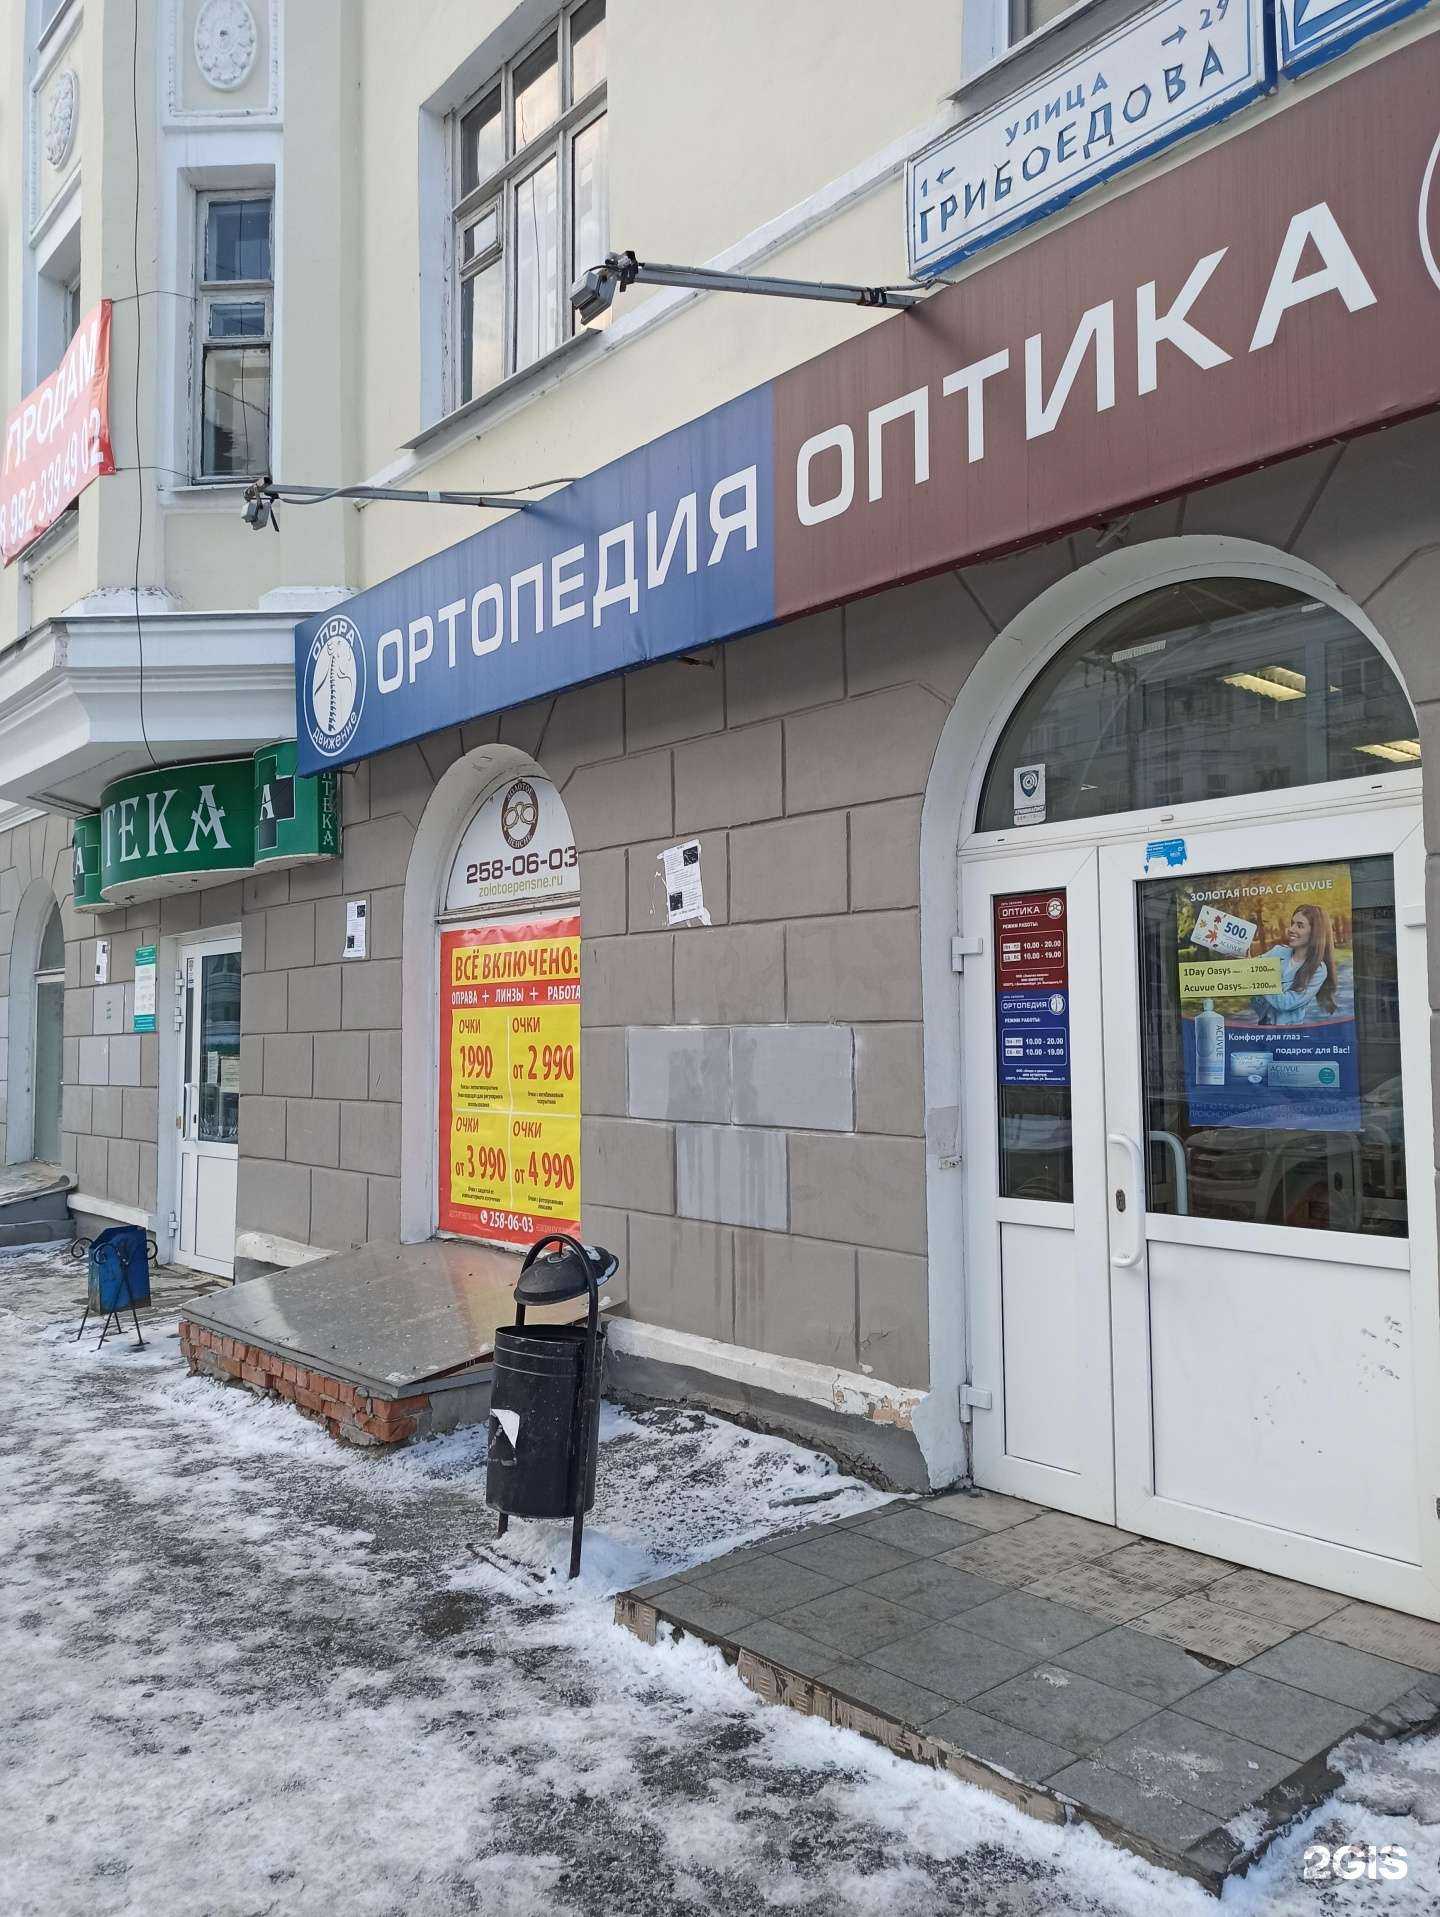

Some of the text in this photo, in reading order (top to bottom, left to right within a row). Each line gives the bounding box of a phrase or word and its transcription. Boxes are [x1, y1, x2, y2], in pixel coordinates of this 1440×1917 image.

[1200, 0, 1229, 30] 29
[1004, 72, 1109, 147] УЛИЦА
[919, 41, 1225, 244] ГРИБОЕДОВА
[920, 178, 928, 197] 1
[796, 201, 1378, 526] ОПТИКА
[5, 319, 98, 476] ПРОДАМ
[376, 463, 758, 695] ОРТОПЕДИЯ
[312, 620, 355, 661] ОПОРА
[259, 783, 275, 821] А
[74, 846, 85, 875] А
[466, 845, 578, 885] 258-06-03
[478, 874, 563, 898] zolotoepensne.ru
[1190, 879, 1333, 902] ЗОЛОТАЯ ПОРА С ACUVUE
[1002, 906, 1040, 917] ОПТИКА
[455, 945, 579, 982] ВСЁ ВКЛЮЧЕНО:
[1023, 952, 1040, 960] 10.00
[1183, 968, 1205, 977] 1Day
[1207, 966, 1232, 976] Oasys
[451, 989, 478, 1006] ОПРАВА
[495, 987, 524, 1003] ЛИНЗЫ
[547, 984, 581, 1001] РАБОТА
[1183, 984, 1215, 992] Acuvue
[1216, 982, 1242, 992] Oasys
[1003, 1001, 1047, 1010] ОРТОПЕДИЯ
[458, 1018, 481, 1034] ОЧКИ
[512, 1016, 541, 1034] ОЧКИ
[1216, 1024, 1224, 1059] ACUVUE
[1228, 1032, 1265, 1042] Комфорт
[1026, 1048, 1042, 1056] 10.00
[1315, 1047, 1331, 1055] для
[1333, 1045, 1350, 1054] Вас!
[455, 1116, 479, 1133] ОЧКИ
[512, 1120, 542, 1139] ОЧКИ
[489, 1210, 534, 1233] 258-06-03
